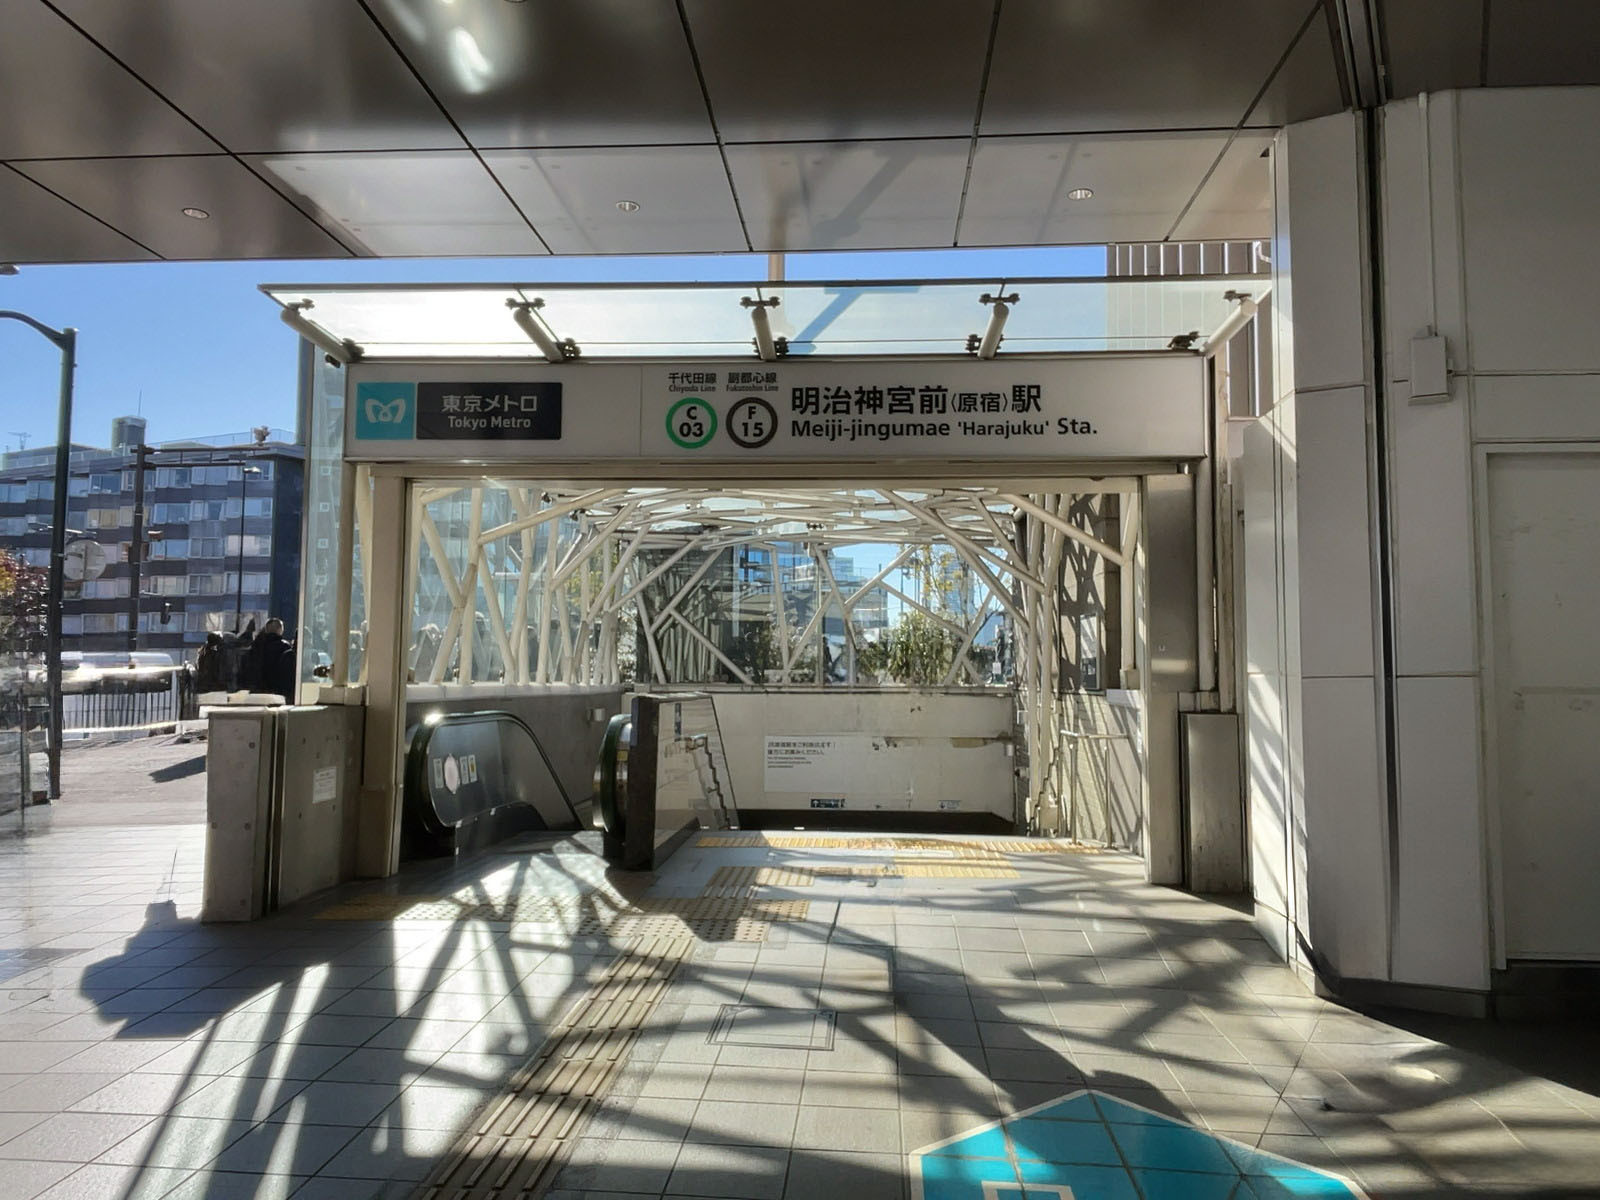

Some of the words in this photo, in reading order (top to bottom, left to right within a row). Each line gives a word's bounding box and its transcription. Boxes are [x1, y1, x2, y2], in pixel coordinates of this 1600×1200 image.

[668, 372, 717, 384] 千代田線
[728, 372, 777, 384] 副都心線
[668, 384, 699, 393] Chiyoda
[700, 384, 716, 392] Line
[764, 384, 779, 392] Line
[441, 394, 538, 413] 東京メトロ
[686, 406, 697, 420] C
[747, 406, 757, 420] F
[447, 415, 487, 430] Tokyo
[489, 415, 532, 430] Metro
[679, 422, 704, 437] 03
[741, 422, 764, 437] 15
[791, 417, 951, 442] Meiji-jingumae
[957, 420, 1050, 437] 'Harajuku'
[1057, 417, 1098, 435] Sta.
